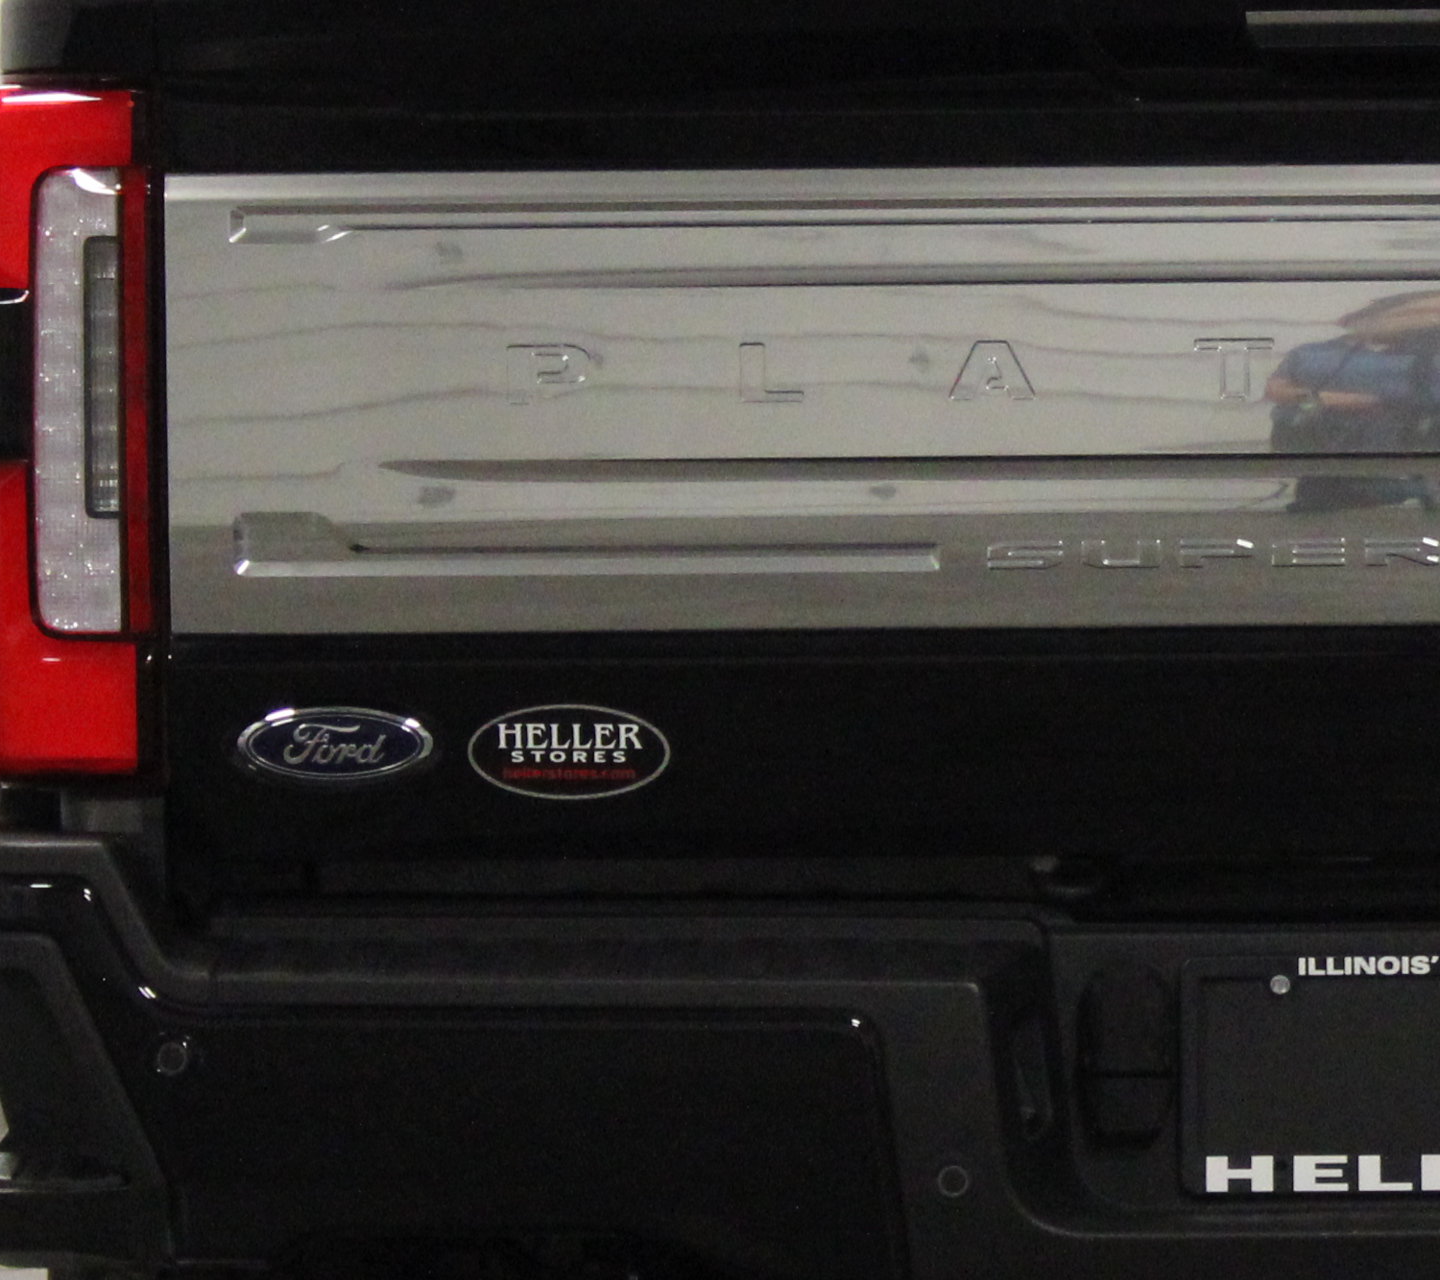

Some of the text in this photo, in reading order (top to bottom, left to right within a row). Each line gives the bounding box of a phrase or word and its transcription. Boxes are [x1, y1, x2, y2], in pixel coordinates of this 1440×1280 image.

[283, 722, 386, 766] Ford
[496, 722, 643, 751] HELLER
[510, 750, 627, 763] STORES
